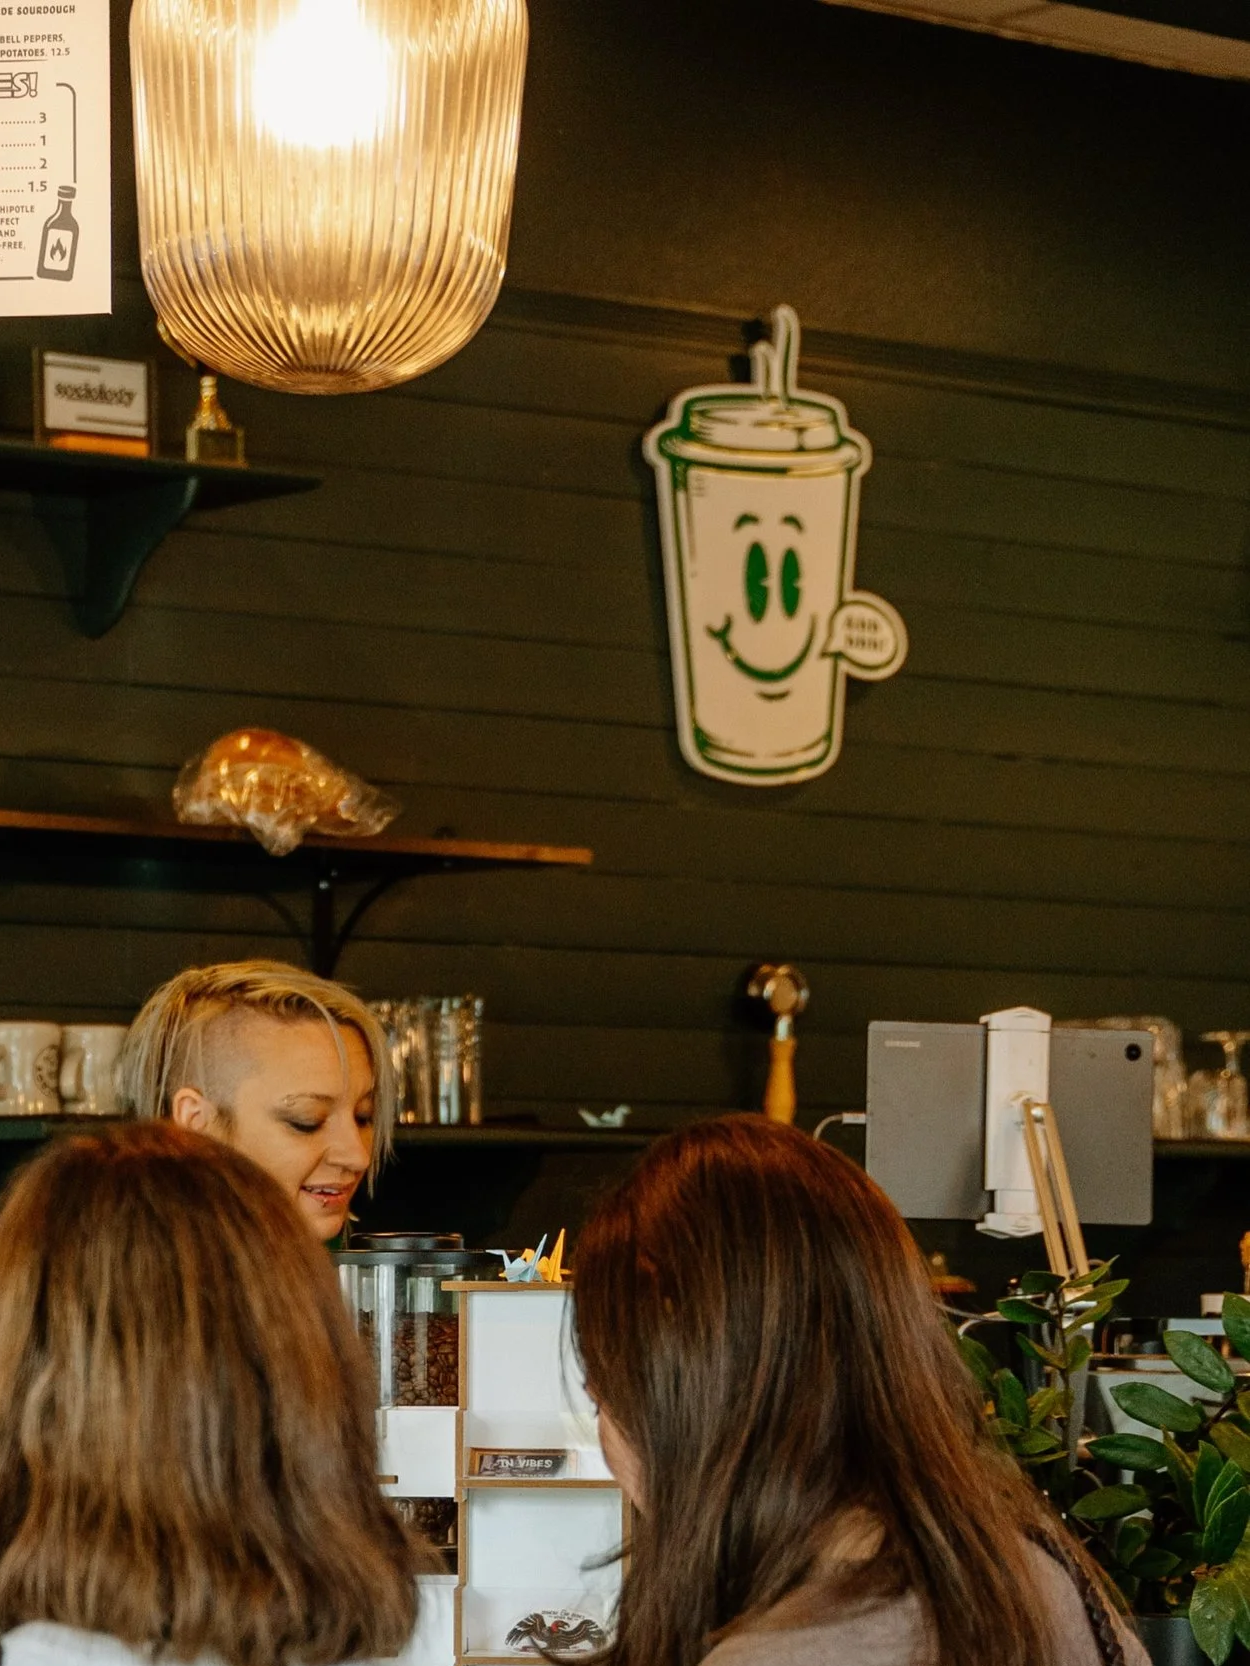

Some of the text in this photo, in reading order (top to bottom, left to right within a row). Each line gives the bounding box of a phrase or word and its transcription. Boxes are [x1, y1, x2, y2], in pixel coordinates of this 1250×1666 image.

[16, 5, 75, 15] SOURDOUGH
[0, 35, 21, 44] BELL
[23, 34, 66, 44] PEPPERS,
[0, 48, 48, 58] POTATOES.
[51, 47, 70, 56] 12.5
[39, 112, 47, 124] 3
[40, 135, 47, 146] 1
[39, 158, 47, 169] 2
[28, 181, 47, 192] 1.5
[519, 1458, 553, 1468] VIBES
